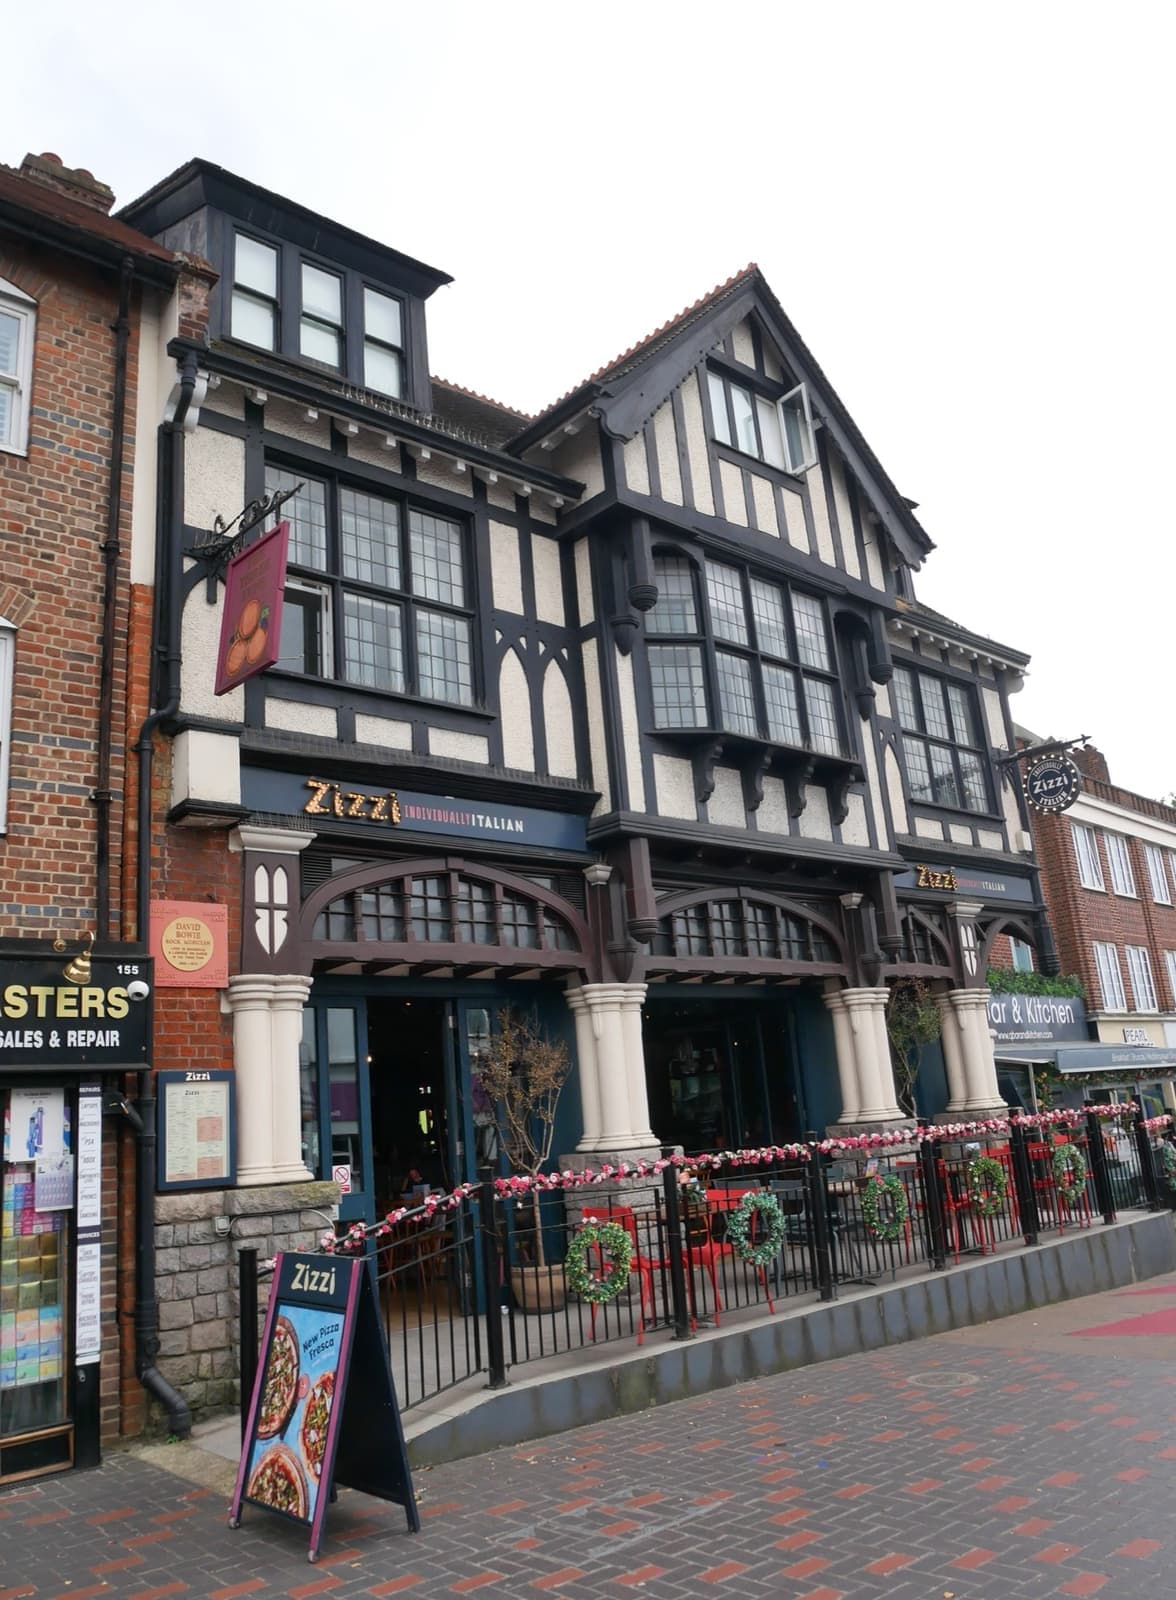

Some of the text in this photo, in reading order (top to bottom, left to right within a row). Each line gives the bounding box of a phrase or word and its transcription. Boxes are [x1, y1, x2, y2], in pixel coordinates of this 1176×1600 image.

[1033, 773, 1069, 794] Zizzi
[303, 776, 402, 825] Zizzi
[471, 814, 524, 833] ITALIAN
[1039, 791, 1068, 806] ITALIAN
[916, 864, 958, 891] Zizzi
[176, 923, 201, 931] DAVID
[176, 931, 201, 939] BOWIE
[116, 965, 139, 975] 155
[0, 985, 129, 1019] STERS
[1011, 996, 1023, 1024] &
[1025, 997, 1075, 1024] Kitchen
[49, 1030, 60, 1048] &
[67, 1030, 120, 1048] REPAIR
[1125, 1029, 1148, 1042] PEARL
[185, 1072, 211, 1081] Zizzi
[290, 1262, 336, 1295] Zizzi
[302, 1322, 340, 1353] New Pizza
[308, 1337, 335, 1361] Fresca
